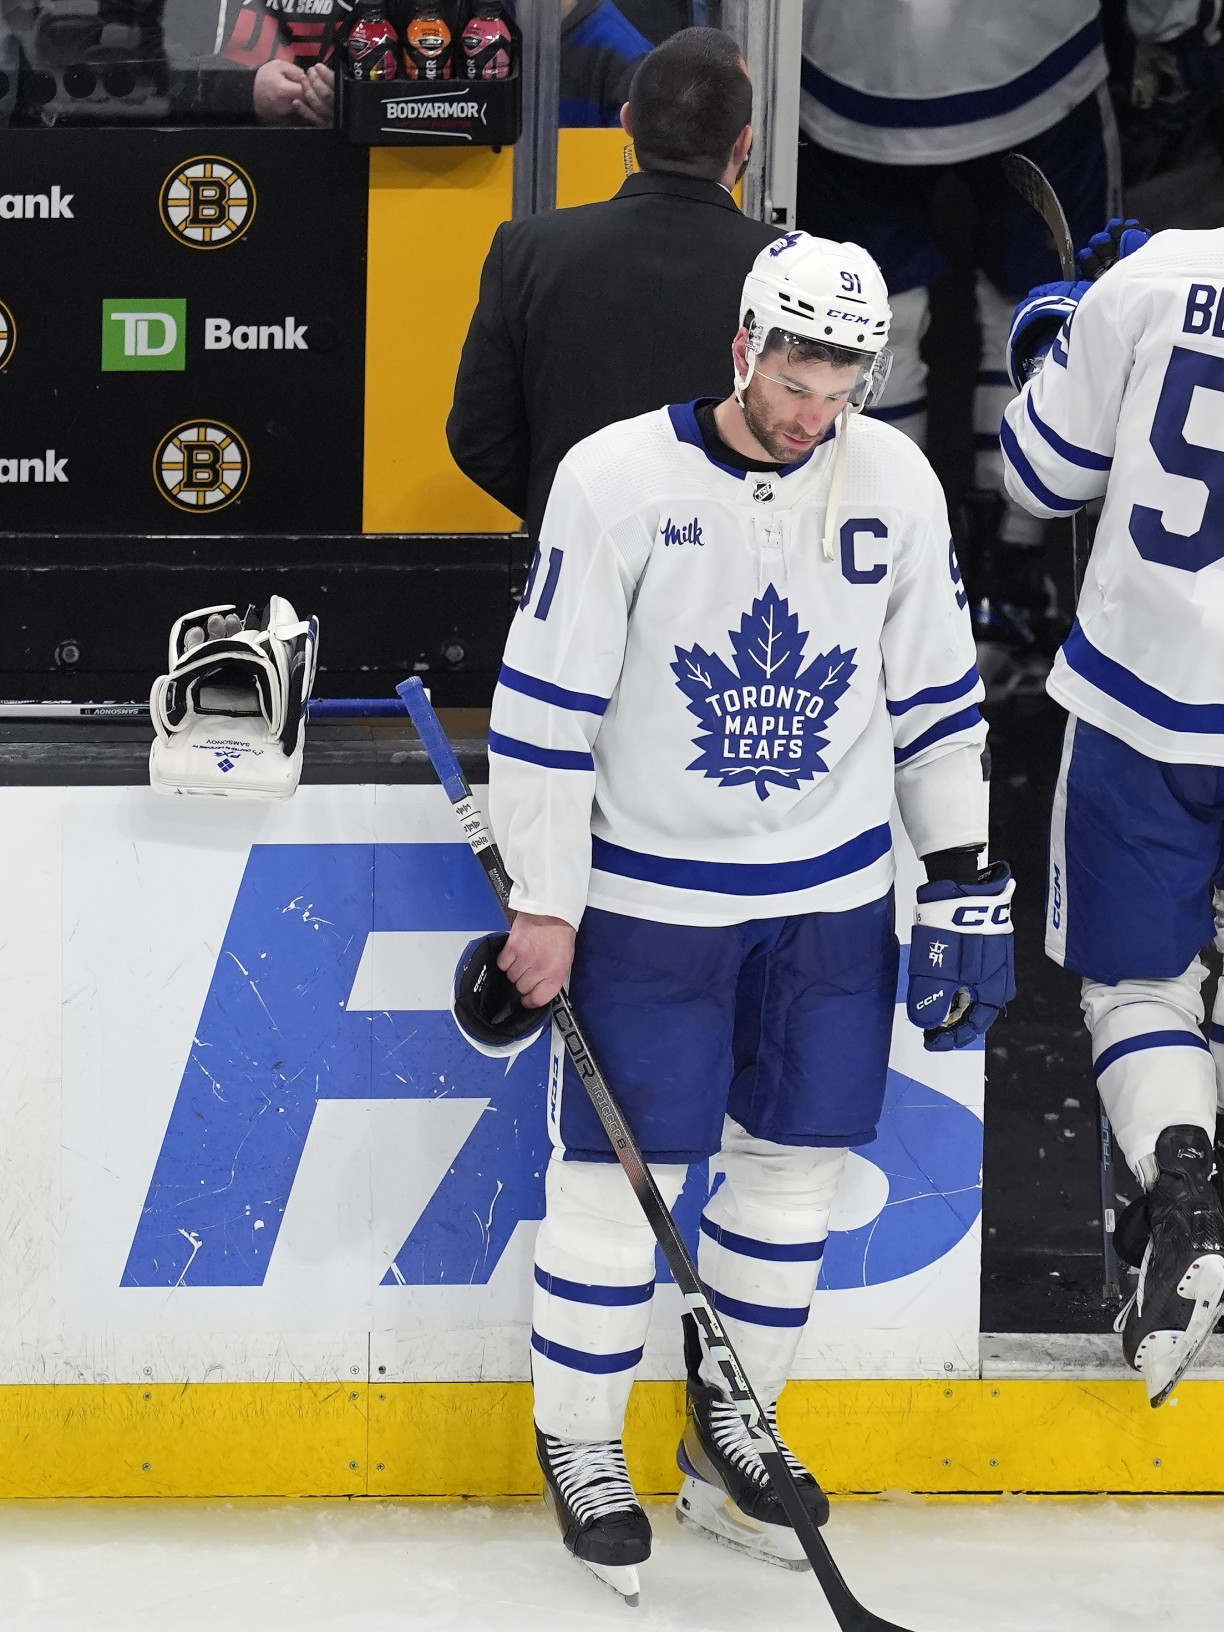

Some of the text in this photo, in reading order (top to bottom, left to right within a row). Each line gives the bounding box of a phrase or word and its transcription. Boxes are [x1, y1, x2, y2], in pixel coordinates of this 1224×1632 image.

[386, 102, 479, 119] BODYARMOR
[840, 271, 862, 294] 91
[826, 308, 871, 325] CCM
[110, 312, 309, 356] TD Bank
[661, 517, 705, 547] Milk
[839, 518, 888, 585] C
[93, 707, 139, 715] SAMSONOV
[704, 684, 826, 720] TORONTO
[724, 715, 805, 736] MAPLE
[206, 739, 250, 747] SAMSONOV
[722, 738, 804, 761] LEAFS
[1052, 863, 1062, 930] CCM
[916, 989, 944, 1010] CCM
[549, 1054, 560, 1125] CCM
[592, 1083, 627, 1149] TRIGGER 8
[684, 1292, 778, 1454] CCM
